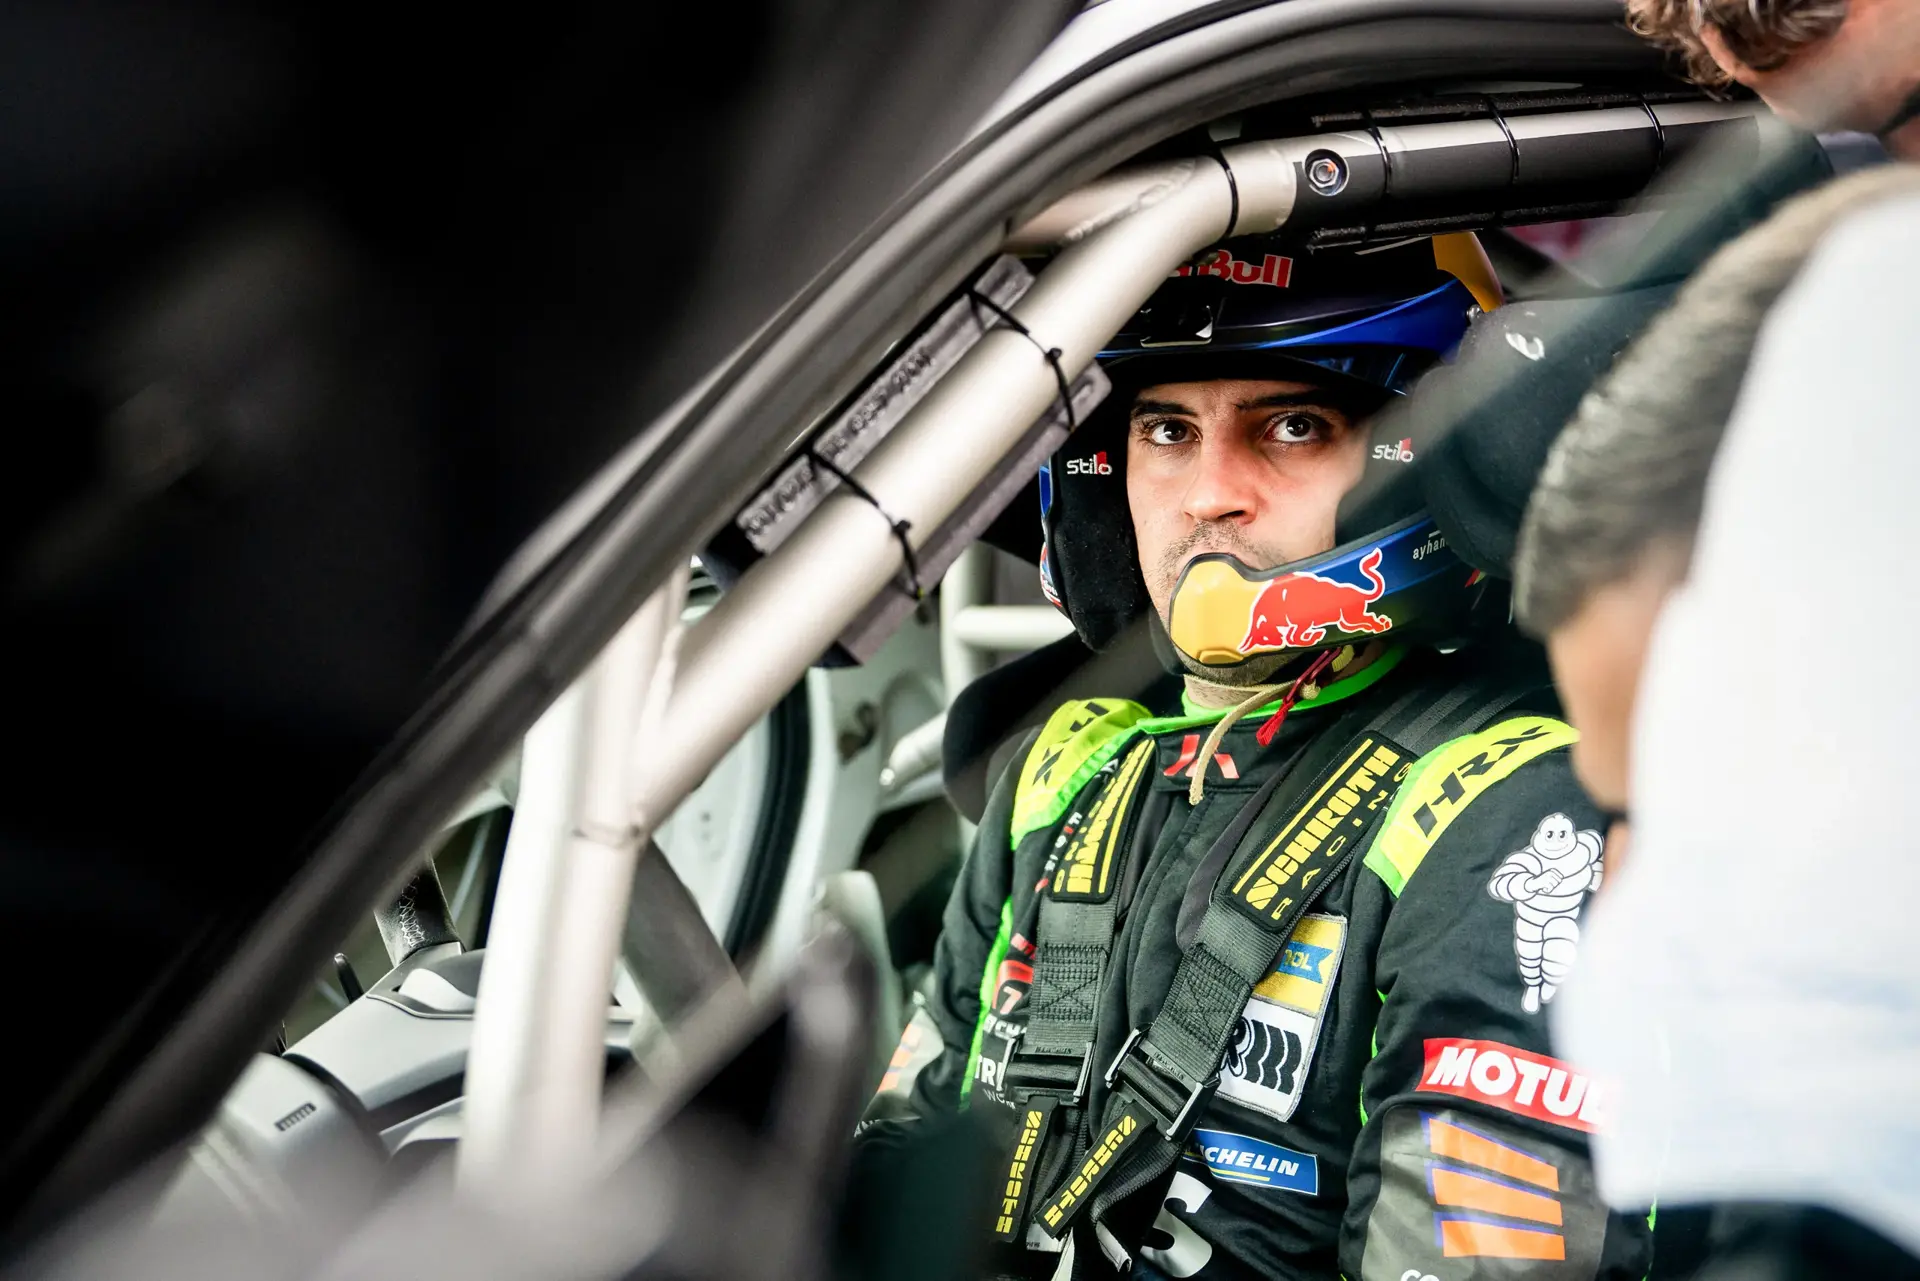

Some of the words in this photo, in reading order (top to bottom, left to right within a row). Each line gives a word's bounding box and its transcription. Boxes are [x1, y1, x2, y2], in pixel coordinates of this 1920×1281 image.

[1412, 537, 1446, 560] ayhan
[1246, 745, 1400, 910] SCHROTH
[1271, 762, 1413, 921] RACING
[996, 1111, 1043, 1234] SCHROTH
[1043, 1115, 1137, 1228] SCHROTH
